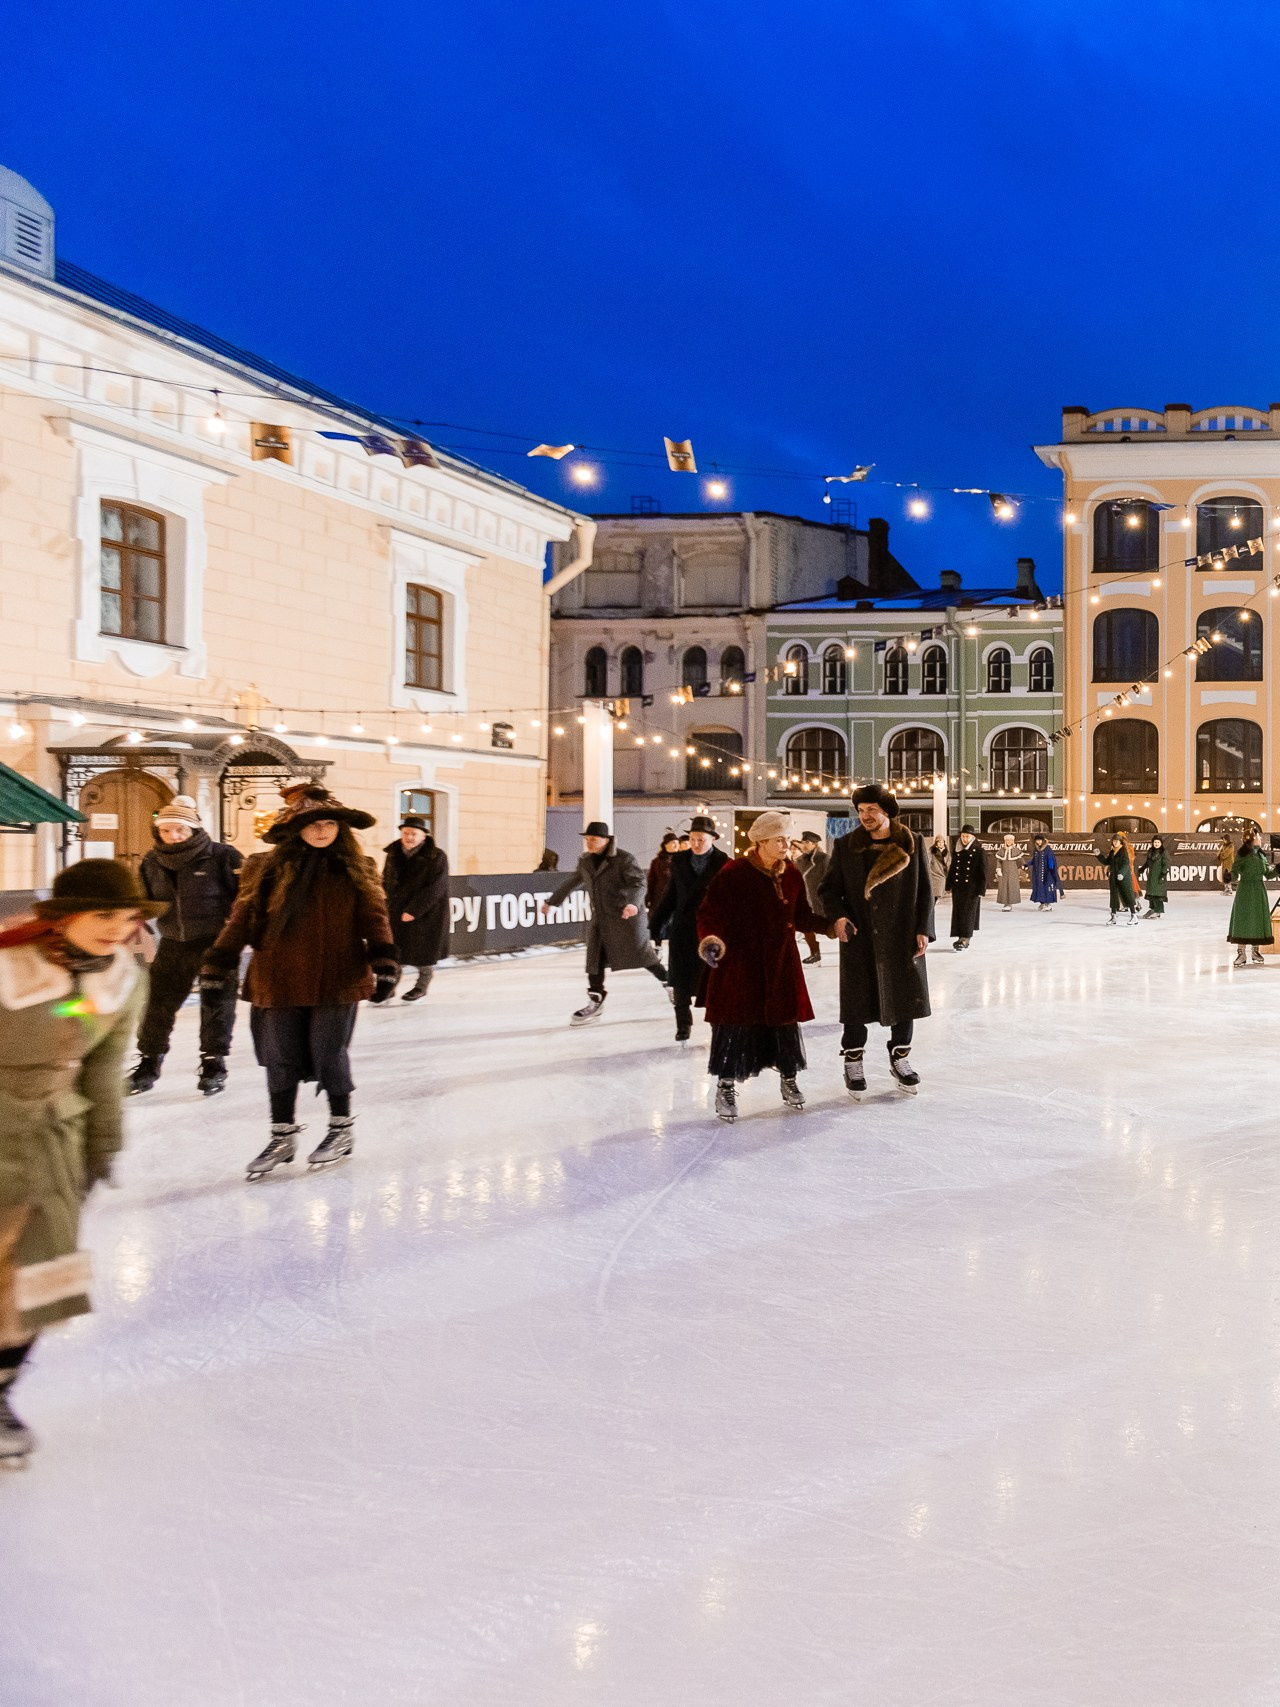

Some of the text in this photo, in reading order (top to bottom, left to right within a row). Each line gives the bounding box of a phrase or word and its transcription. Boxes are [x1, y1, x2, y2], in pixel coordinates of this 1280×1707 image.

[988, 843, 1028, 851] БАЛКА
[1053, 843, 1093, 851] БАЛТИКА
[486, 889, 592, 931] ГОСТИНК
